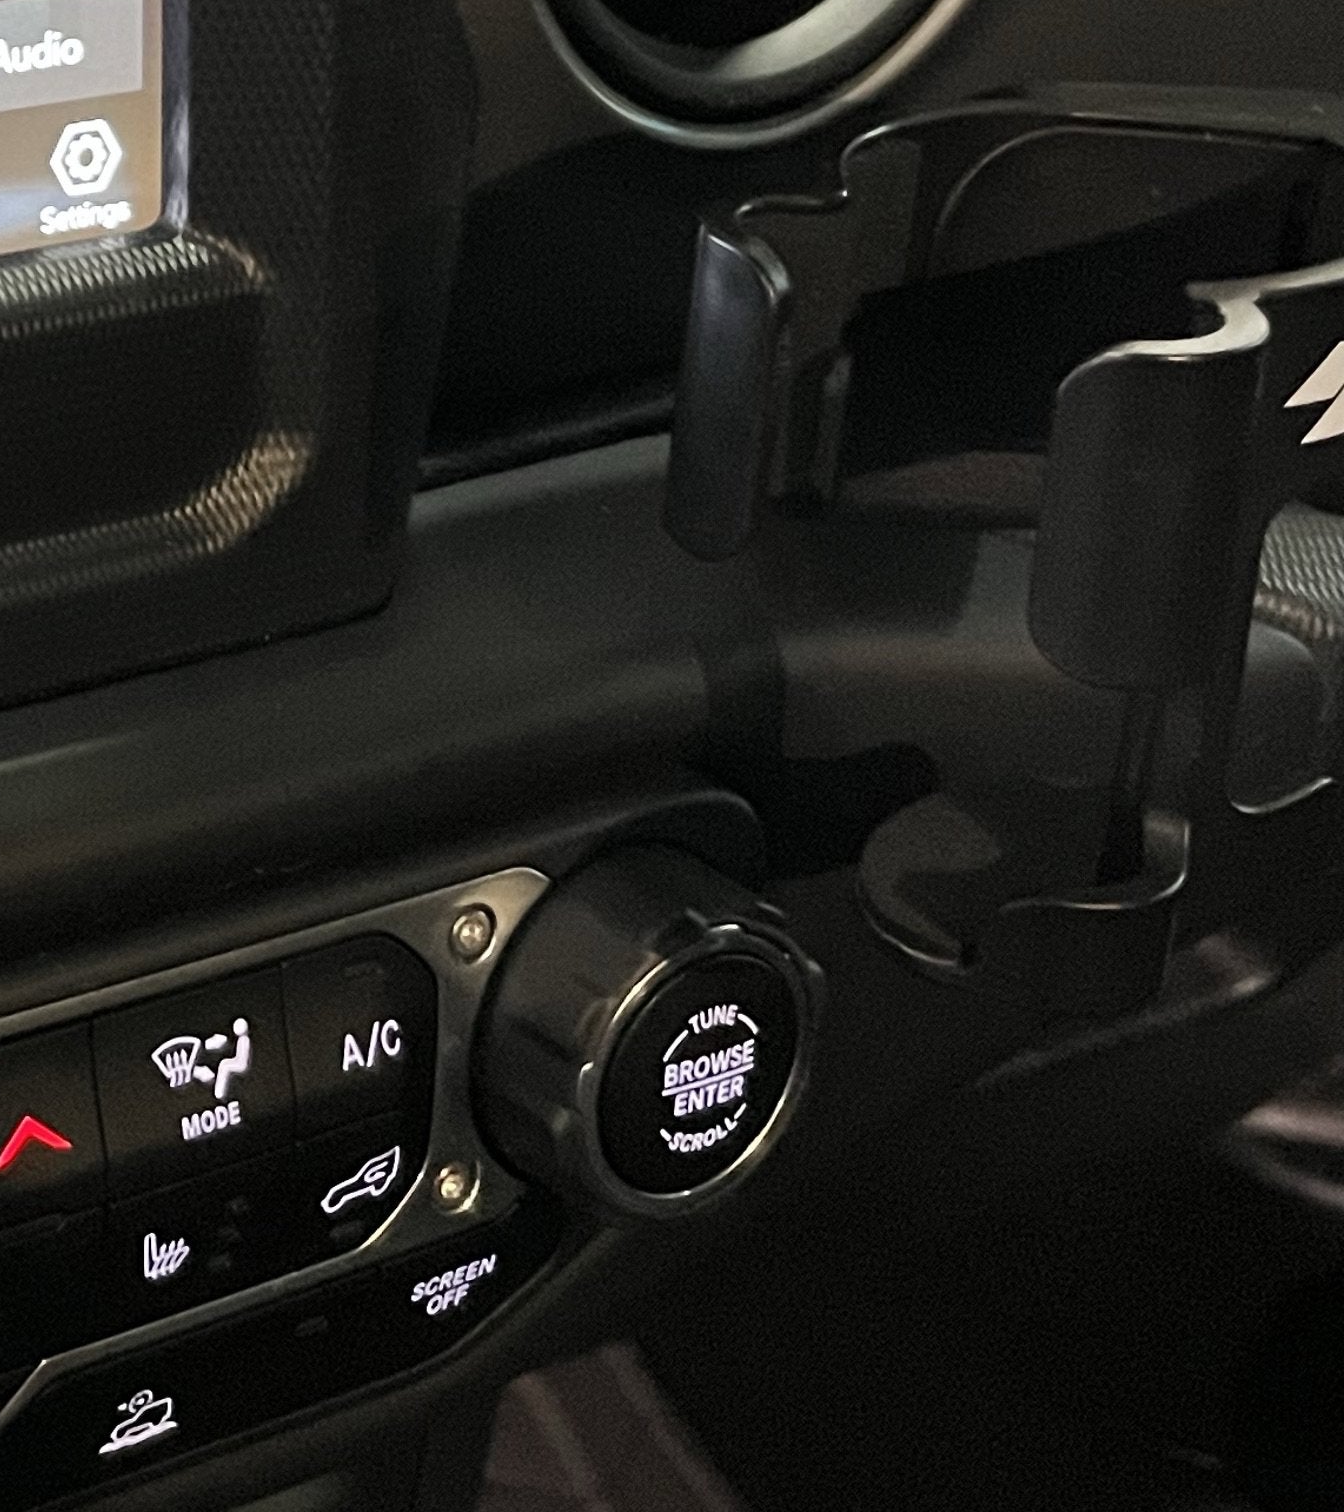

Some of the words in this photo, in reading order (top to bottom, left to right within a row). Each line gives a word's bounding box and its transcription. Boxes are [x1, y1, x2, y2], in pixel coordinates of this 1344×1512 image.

[39, 197, 132, 235] Settings
[687, 1002, 739, 1035] TUNE
[342, 1019, 401, 1072] A/C
[663, 1038, 755, 1089] BROWSE
[673, 1079, 746, 1118] ENTER
[181, 1101, 242, 1141] MODE
[668, 1116, 738, 1153] SCROLL
[411, 1255, 496, 1303] SCREEN
[425, 1284, 471, 1316] OFF
